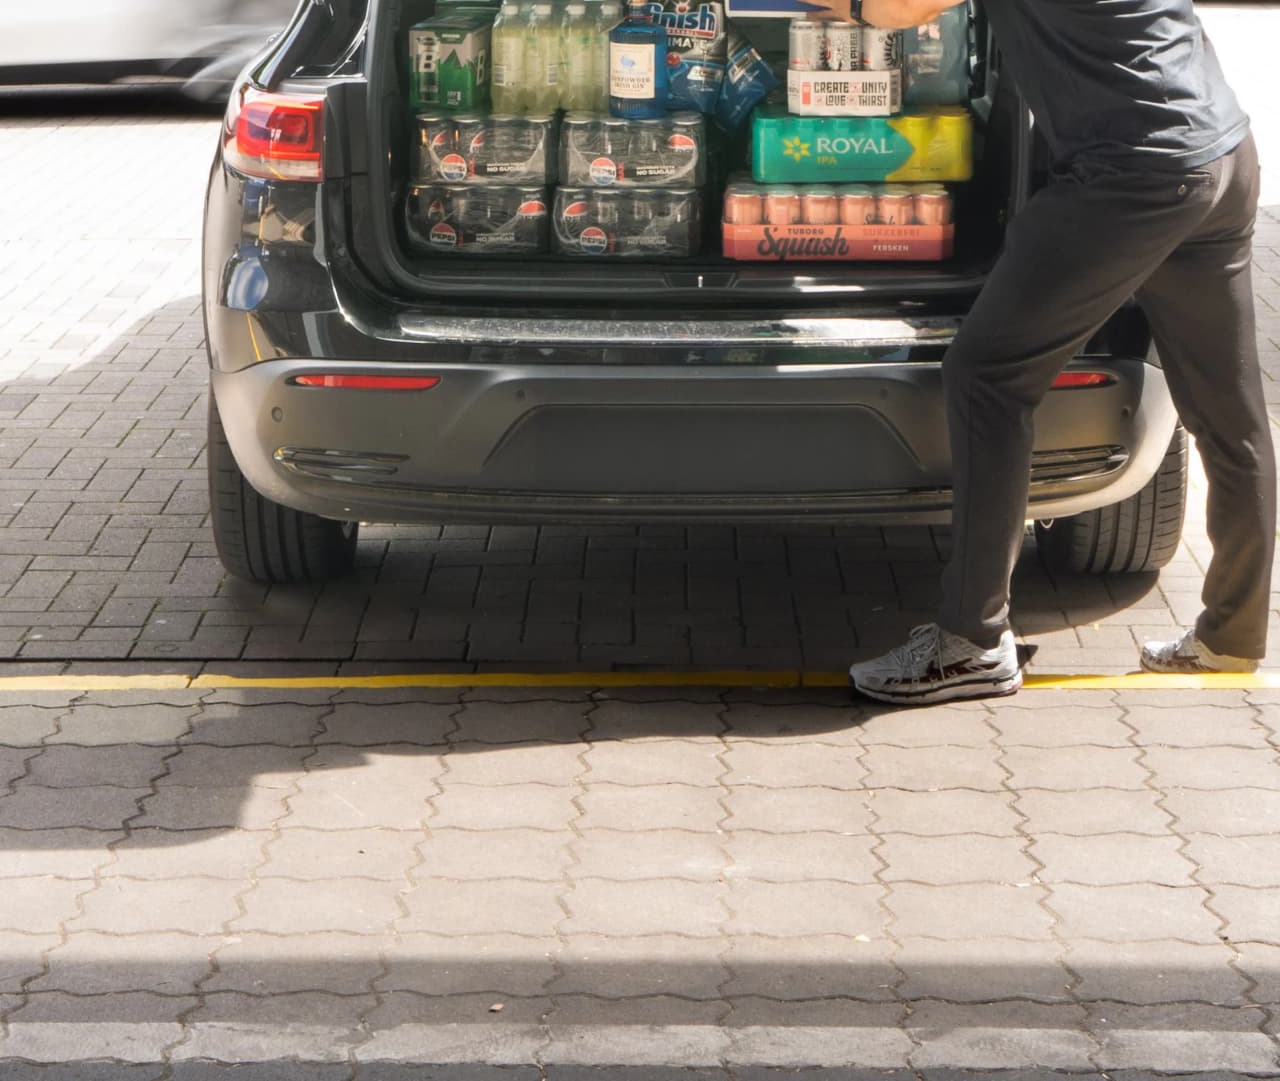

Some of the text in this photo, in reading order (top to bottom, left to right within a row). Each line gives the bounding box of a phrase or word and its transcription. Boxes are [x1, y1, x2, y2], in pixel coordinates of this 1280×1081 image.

[814, 81, 849, 94] CREATE
[862, 81, 888, 94] UNITY
[858, 95, 887, 106] THIRST
[816, 137, 894, 154] ROYAL
[787, 228, 825, 236] TUBORG
[757, 226, 850, 260] Squash
[872, 244, 909, 252] FERSKEN
